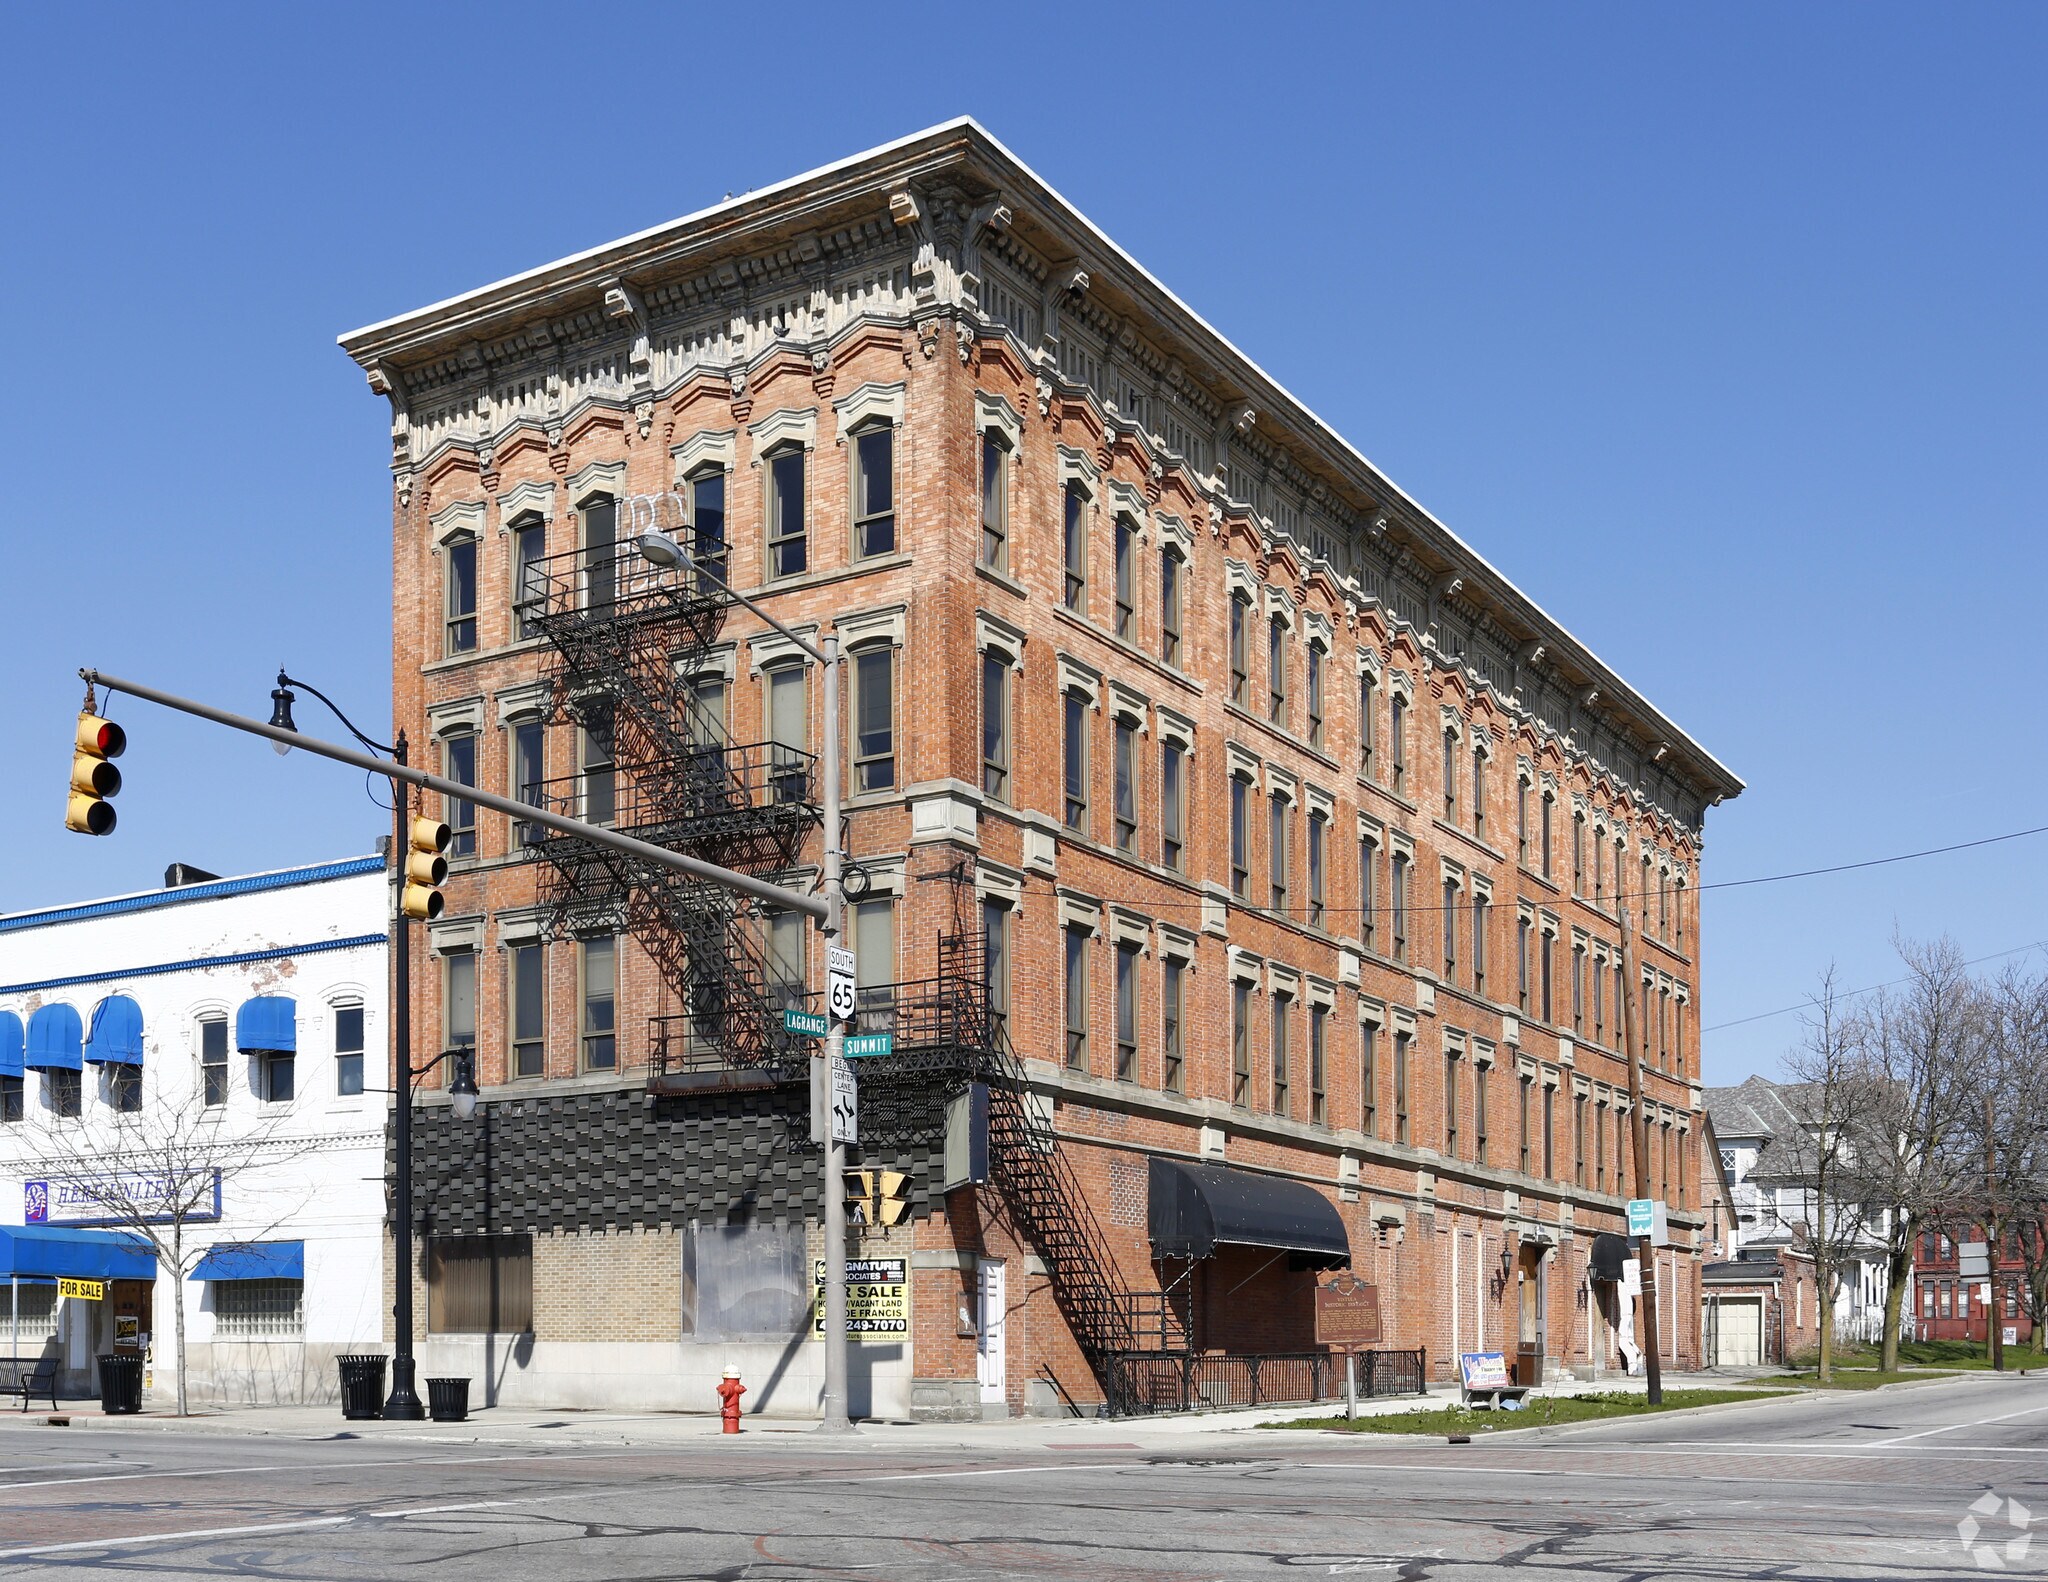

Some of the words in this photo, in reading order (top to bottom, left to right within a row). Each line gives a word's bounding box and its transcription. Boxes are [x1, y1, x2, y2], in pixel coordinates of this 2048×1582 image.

[831, 951, 854, 969] SOUTH
[833, 983, 853, 1009] 65
[786, 1013, 825, 1034] LAGRANGE
[847, 1037, 887, 1055] SUMMIT
[834, 1058, 854, 1071] BEGIN
[834, 1072, 854, 1082] CENTER
[837, 1082, 851, 1091] LANE
[837, 1129, 851, 1137] ONLY
[846, 1261, 901, 1271] GNATURE
[60, 1281, 78, 1295] FOR
[80, 1283, 101, 1297] SALE
[818, 1286, 852, 1298] FR
[857, 1286, 902, 1298] SALE
[860, 1309, 902, 1317] FRANCIS
